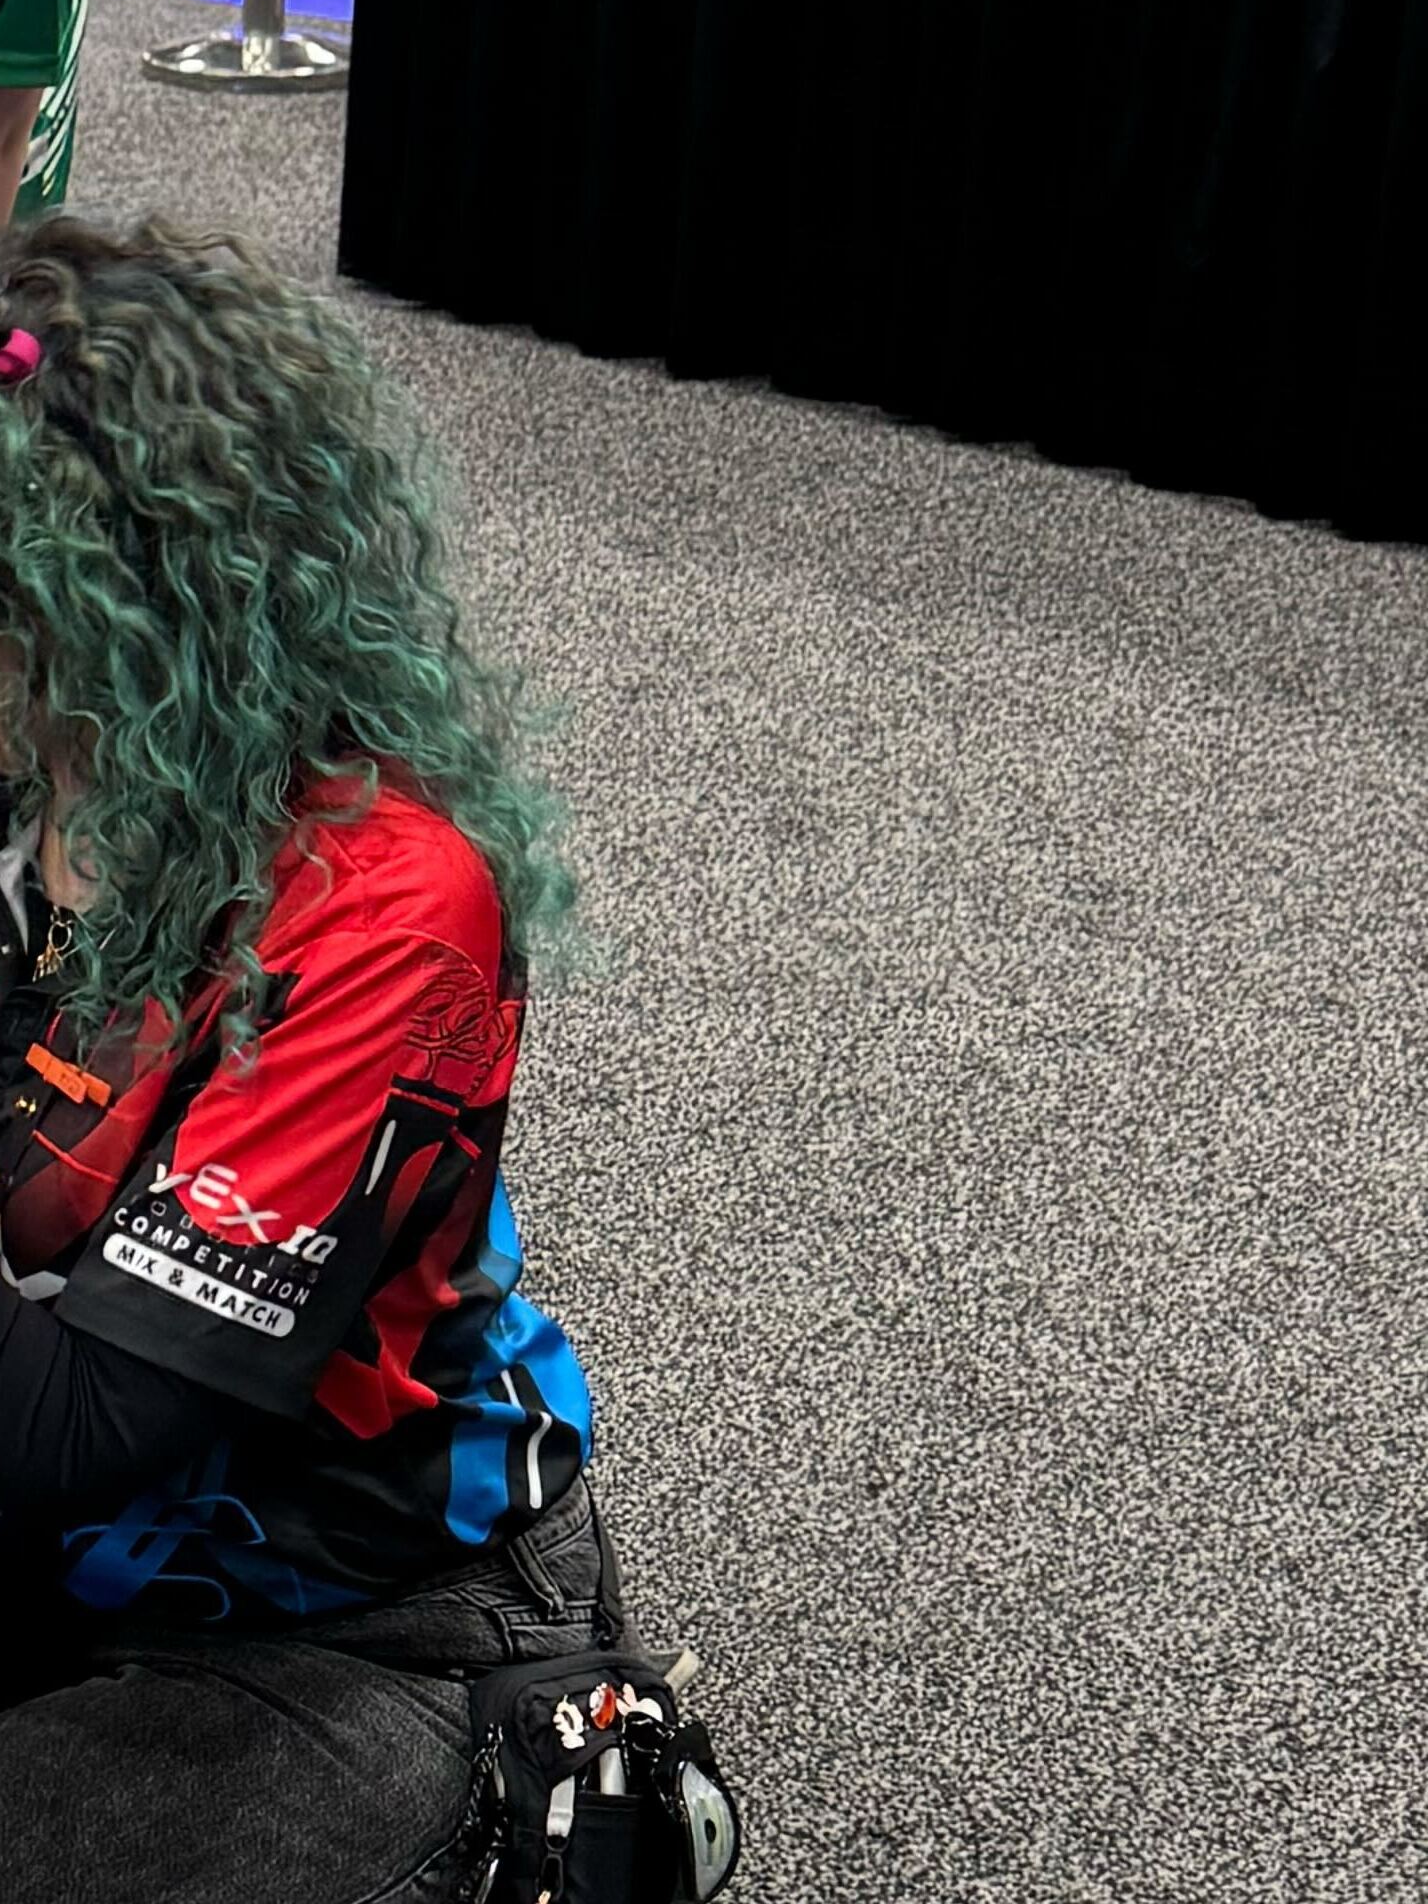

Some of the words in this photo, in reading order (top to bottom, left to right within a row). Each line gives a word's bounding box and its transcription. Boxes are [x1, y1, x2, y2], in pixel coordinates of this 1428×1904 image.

[114, 1207, 311, 1307] COMPETITION
[148, 1162, 282, 1244] VEX
[277, 1224, 339, 1265] IQ
[117, 1244, 159, 1275] MIX
[168, 1267, 186, 1288] &
[195, 1282, 282, 1331] MATCH
